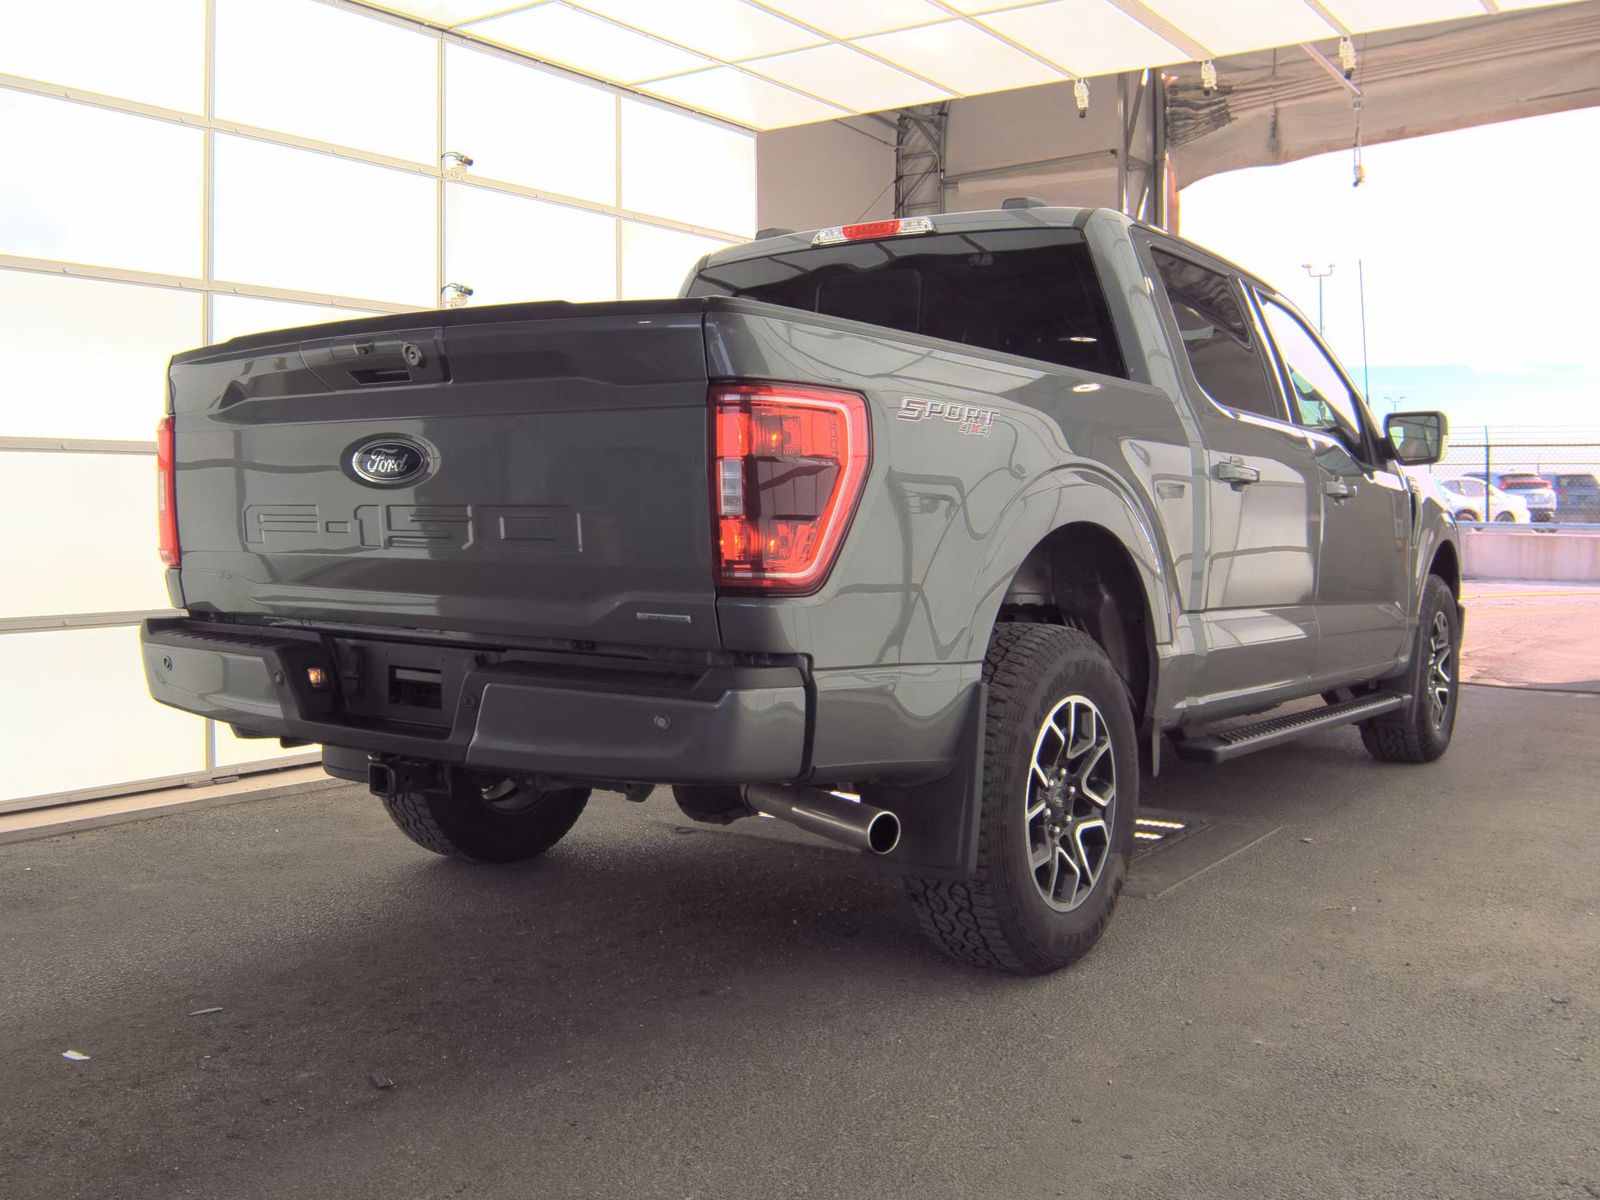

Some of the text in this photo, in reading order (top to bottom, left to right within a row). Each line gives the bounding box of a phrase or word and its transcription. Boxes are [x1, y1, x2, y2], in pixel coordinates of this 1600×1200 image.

[897, 397, 1000, 424] SPORT
[367, 447, 409, 473] Ford
[242, 503, 583, 552] F-150
